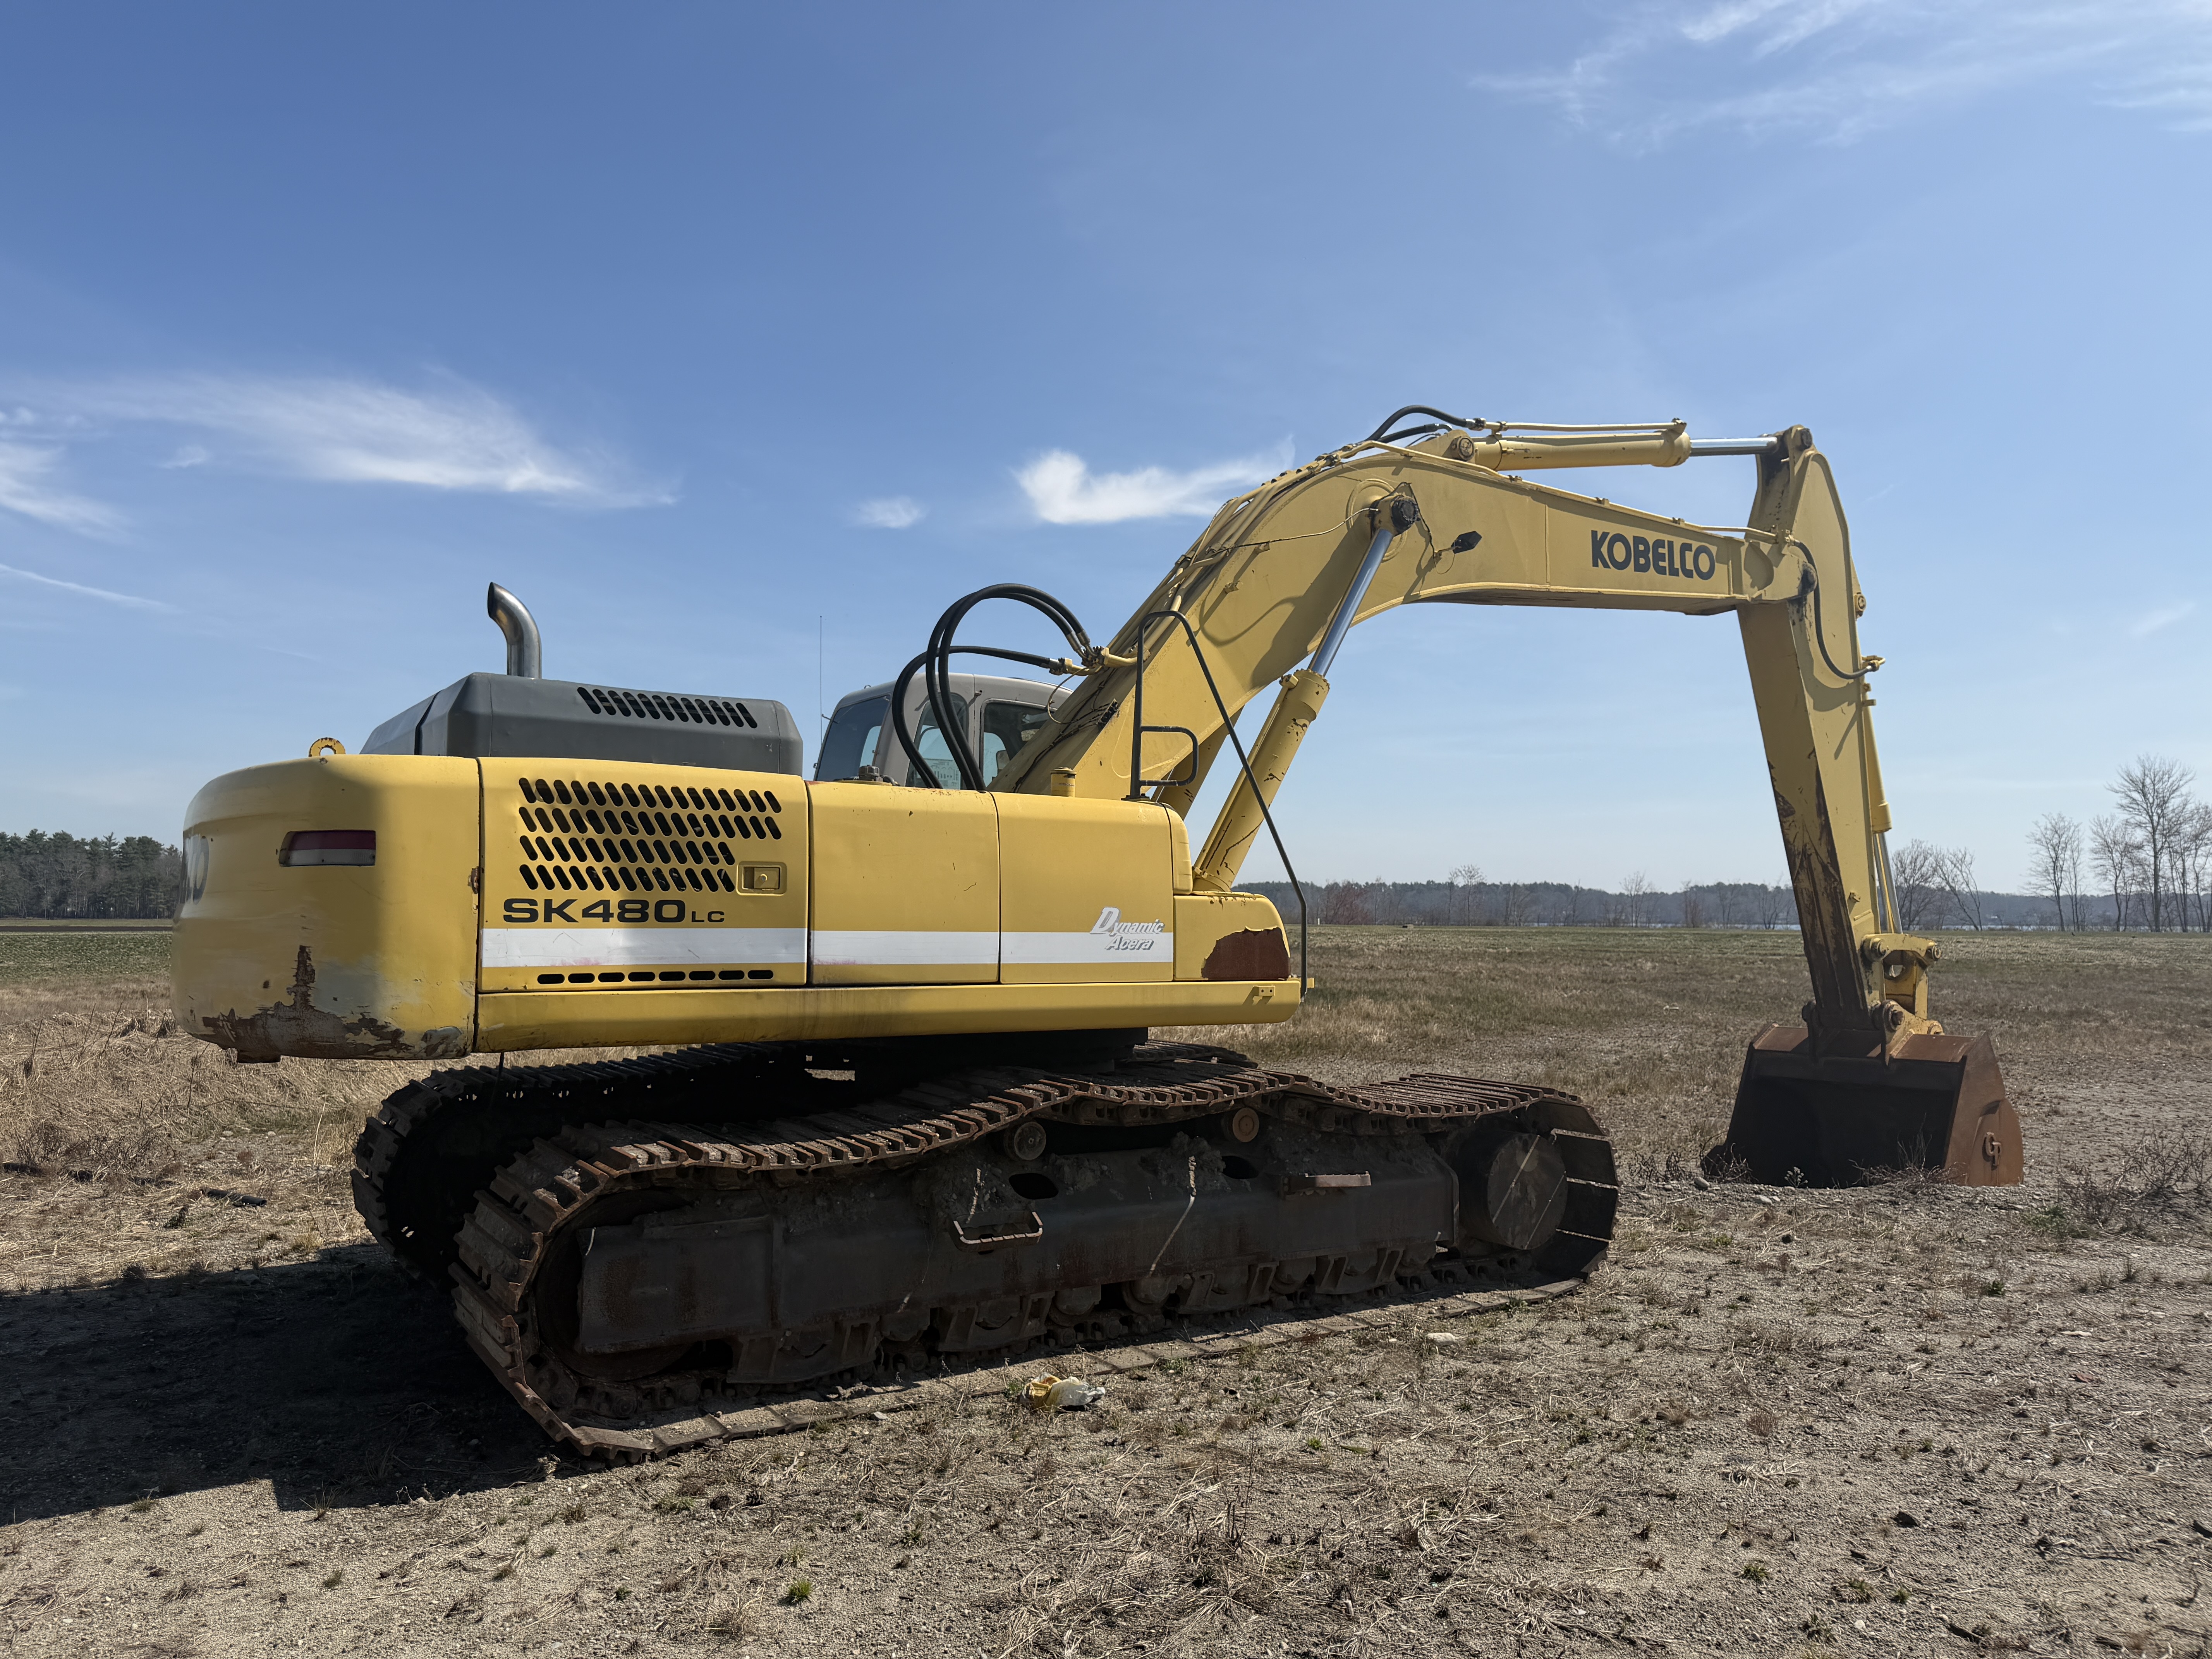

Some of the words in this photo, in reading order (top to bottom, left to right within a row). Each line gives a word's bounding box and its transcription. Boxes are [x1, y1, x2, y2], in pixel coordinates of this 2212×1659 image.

[1591, 530, 1716, 580] KOBELCO
[1090, 906, 1165, 937] Dynamic
[1104, 935, 1154, 951] Acera
